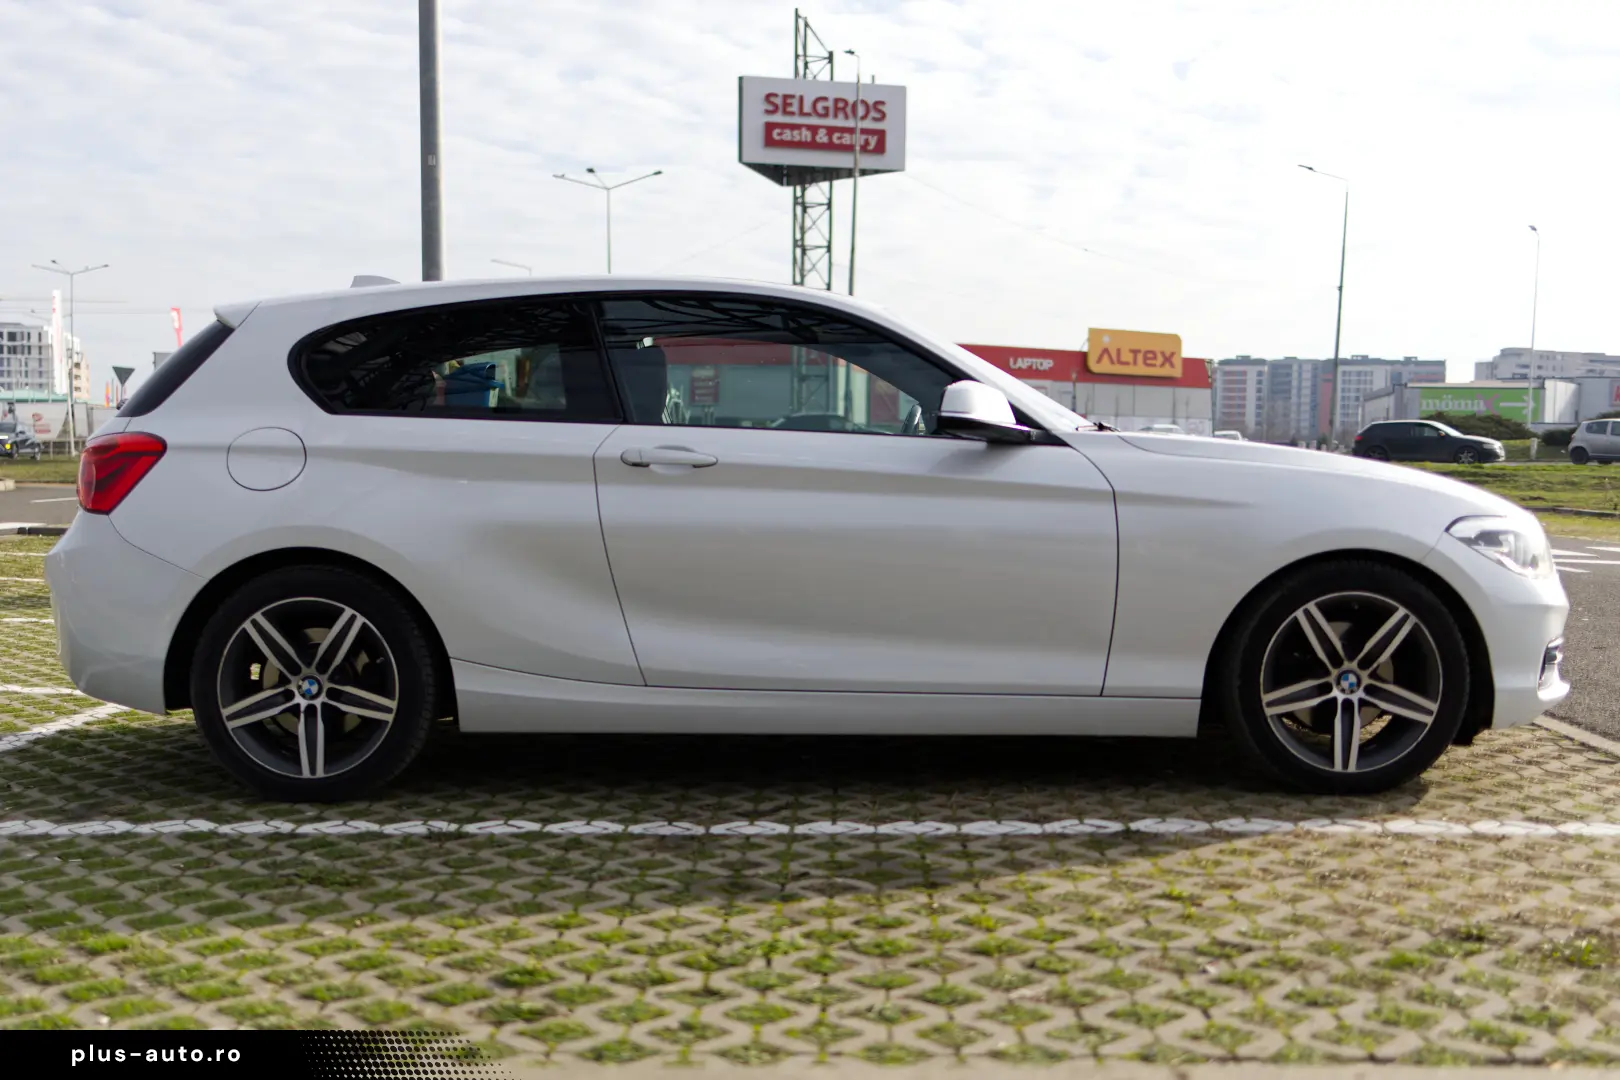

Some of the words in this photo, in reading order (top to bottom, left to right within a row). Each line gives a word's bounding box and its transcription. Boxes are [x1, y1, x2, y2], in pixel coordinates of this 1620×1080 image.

[764, 92, 887, 122] SELGROS
[772, 127, 812, 142] cash
[815, 128, 829, 143] &
[1009, 357, 1054, 371] LAPTOP
